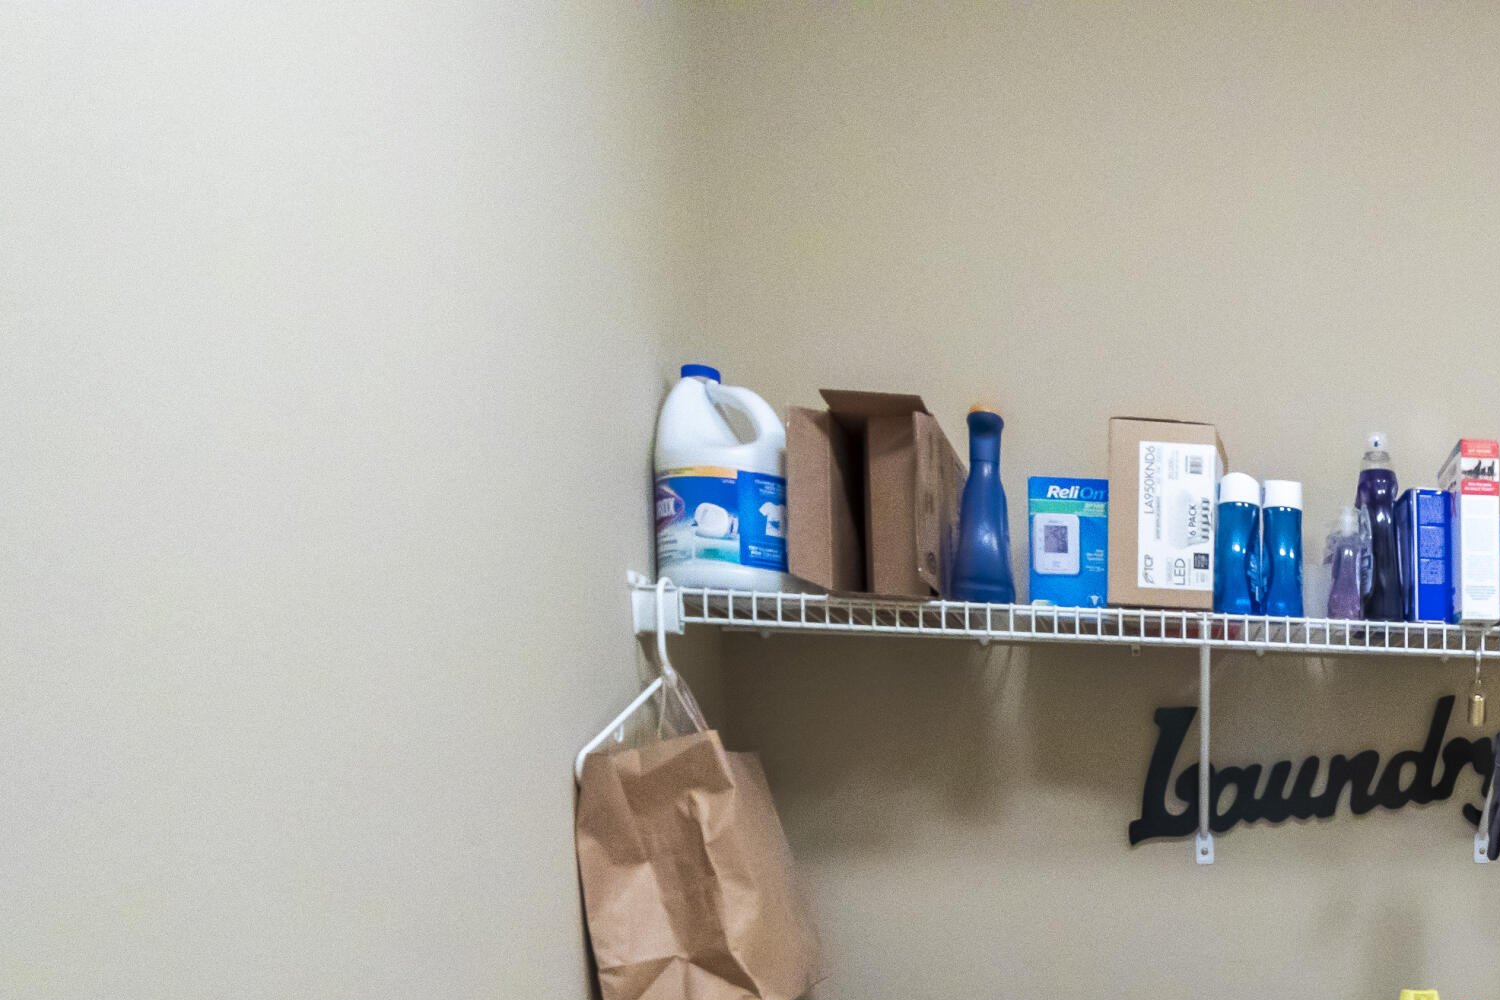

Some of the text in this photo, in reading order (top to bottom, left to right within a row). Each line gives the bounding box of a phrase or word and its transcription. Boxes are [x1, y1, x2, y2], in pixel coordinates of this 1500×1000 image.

[1046, 484, 1105, 501] ReliOn
[1188, 504, 1197, 528] PACK
[1174, 558, 1186, 586] LED
